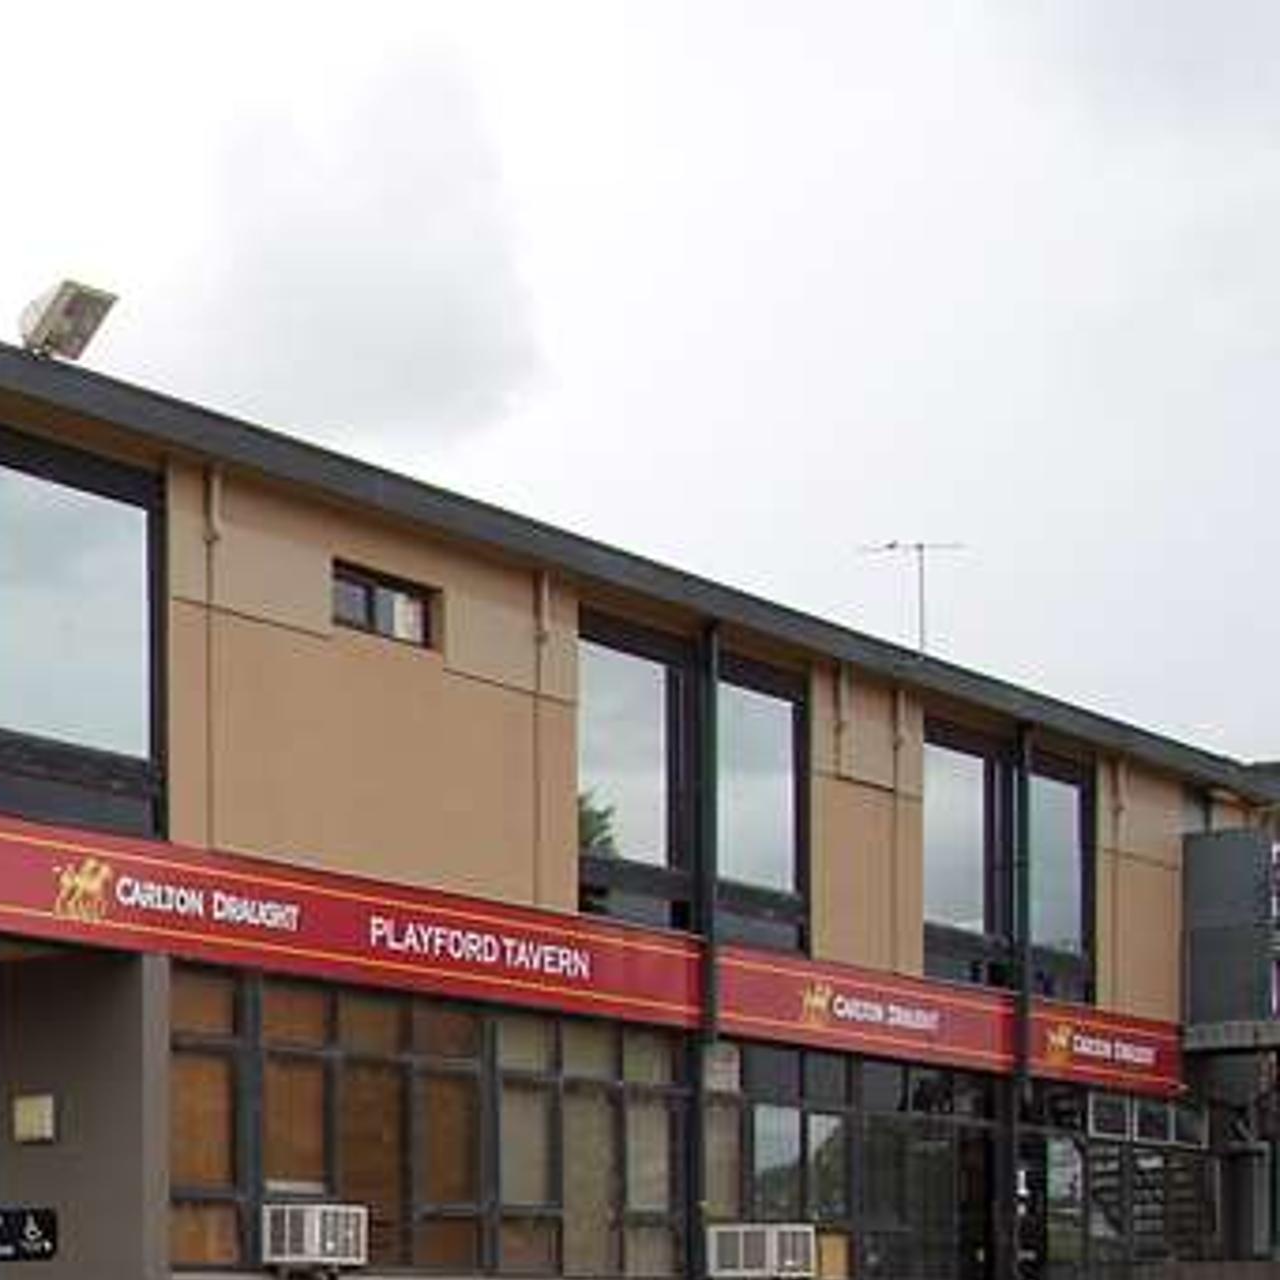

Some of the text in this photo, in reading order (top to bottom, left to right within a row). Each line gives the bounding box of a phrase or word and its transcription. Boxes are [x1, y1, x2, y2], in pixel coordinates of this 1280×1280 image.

[114, 876, 302, 933] CARLTON DRAUGHT
[369, 915, 591, 979] PLAYFORD TAVERN
